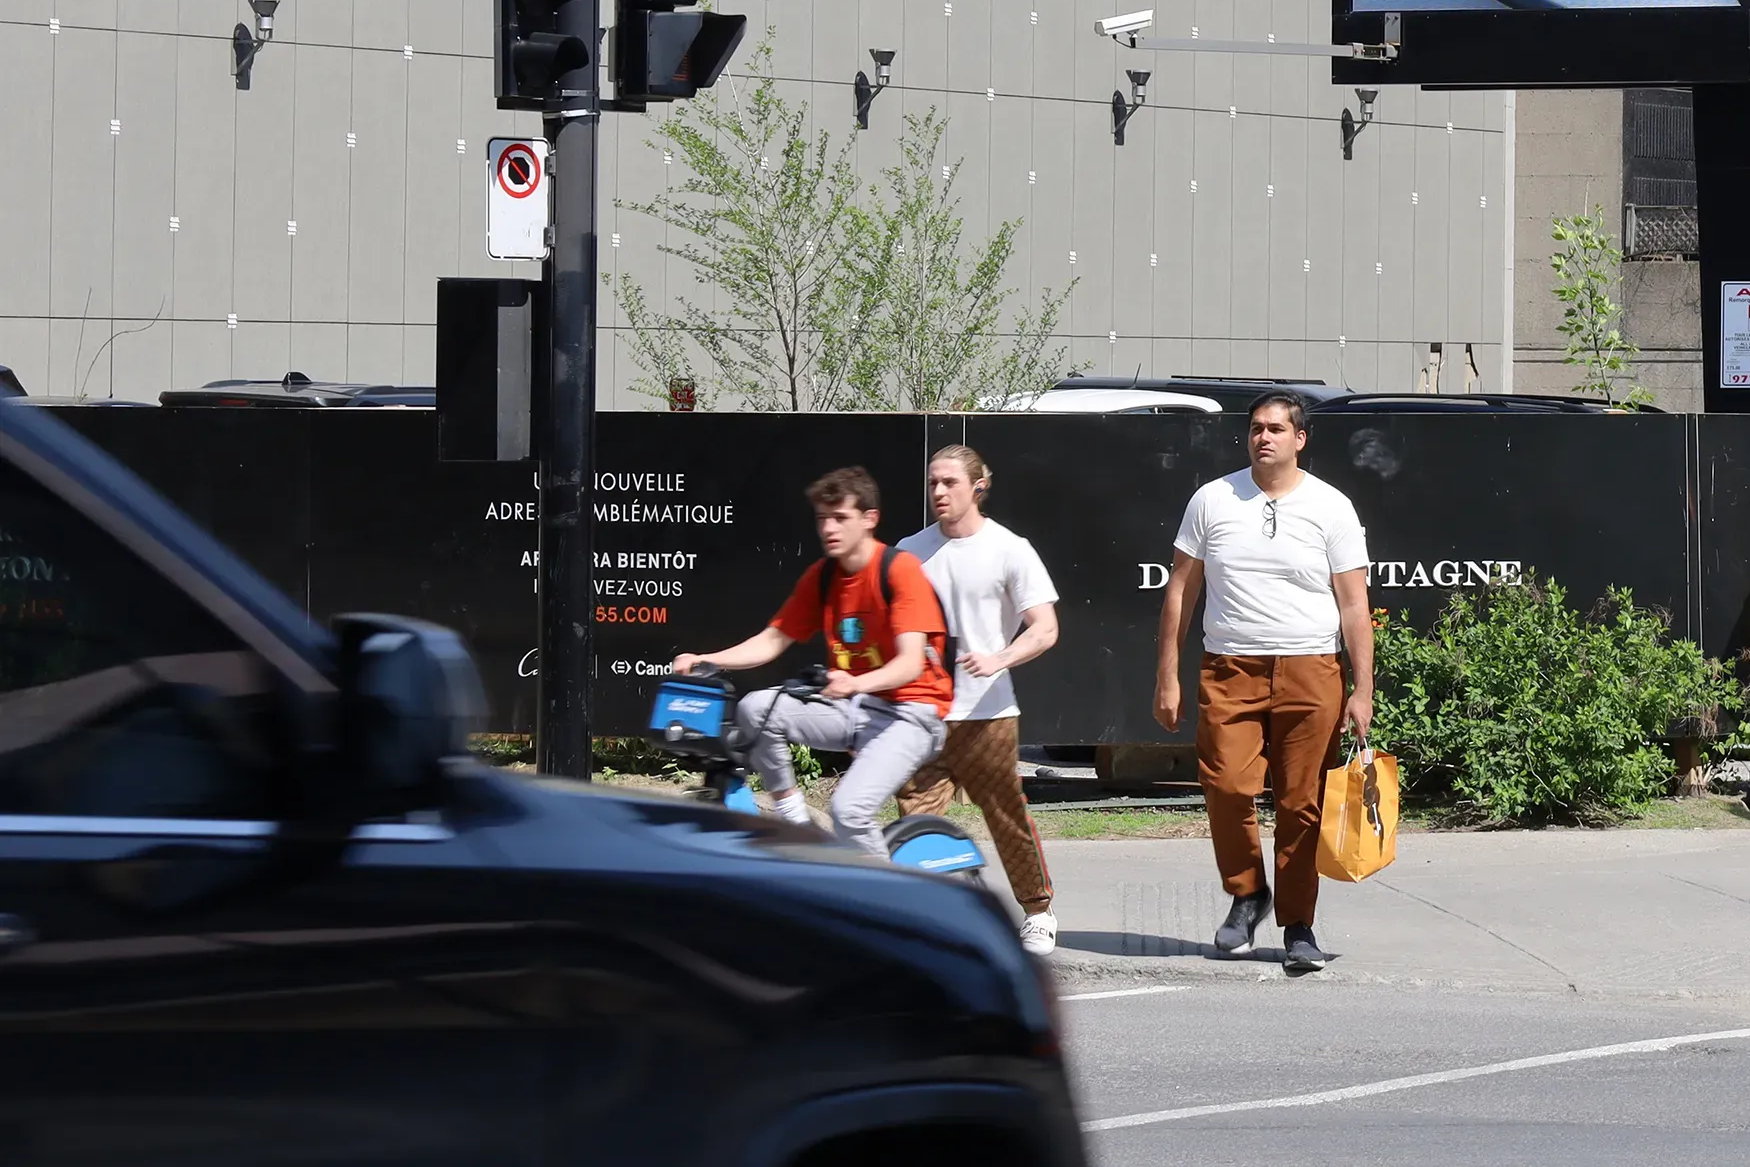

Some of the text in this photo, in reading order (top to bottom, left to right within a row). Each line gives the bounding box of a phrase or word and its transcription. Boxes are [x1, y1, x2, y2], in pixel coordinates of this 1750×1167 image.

[485, 499, 734, 524] ADRE MBLÉMATIQUE
[616, 550, 697, 570] BIENTÔT
[1137, 559, 1523, 590] D TAGNE
[634, 659, 675, 676] Cand
